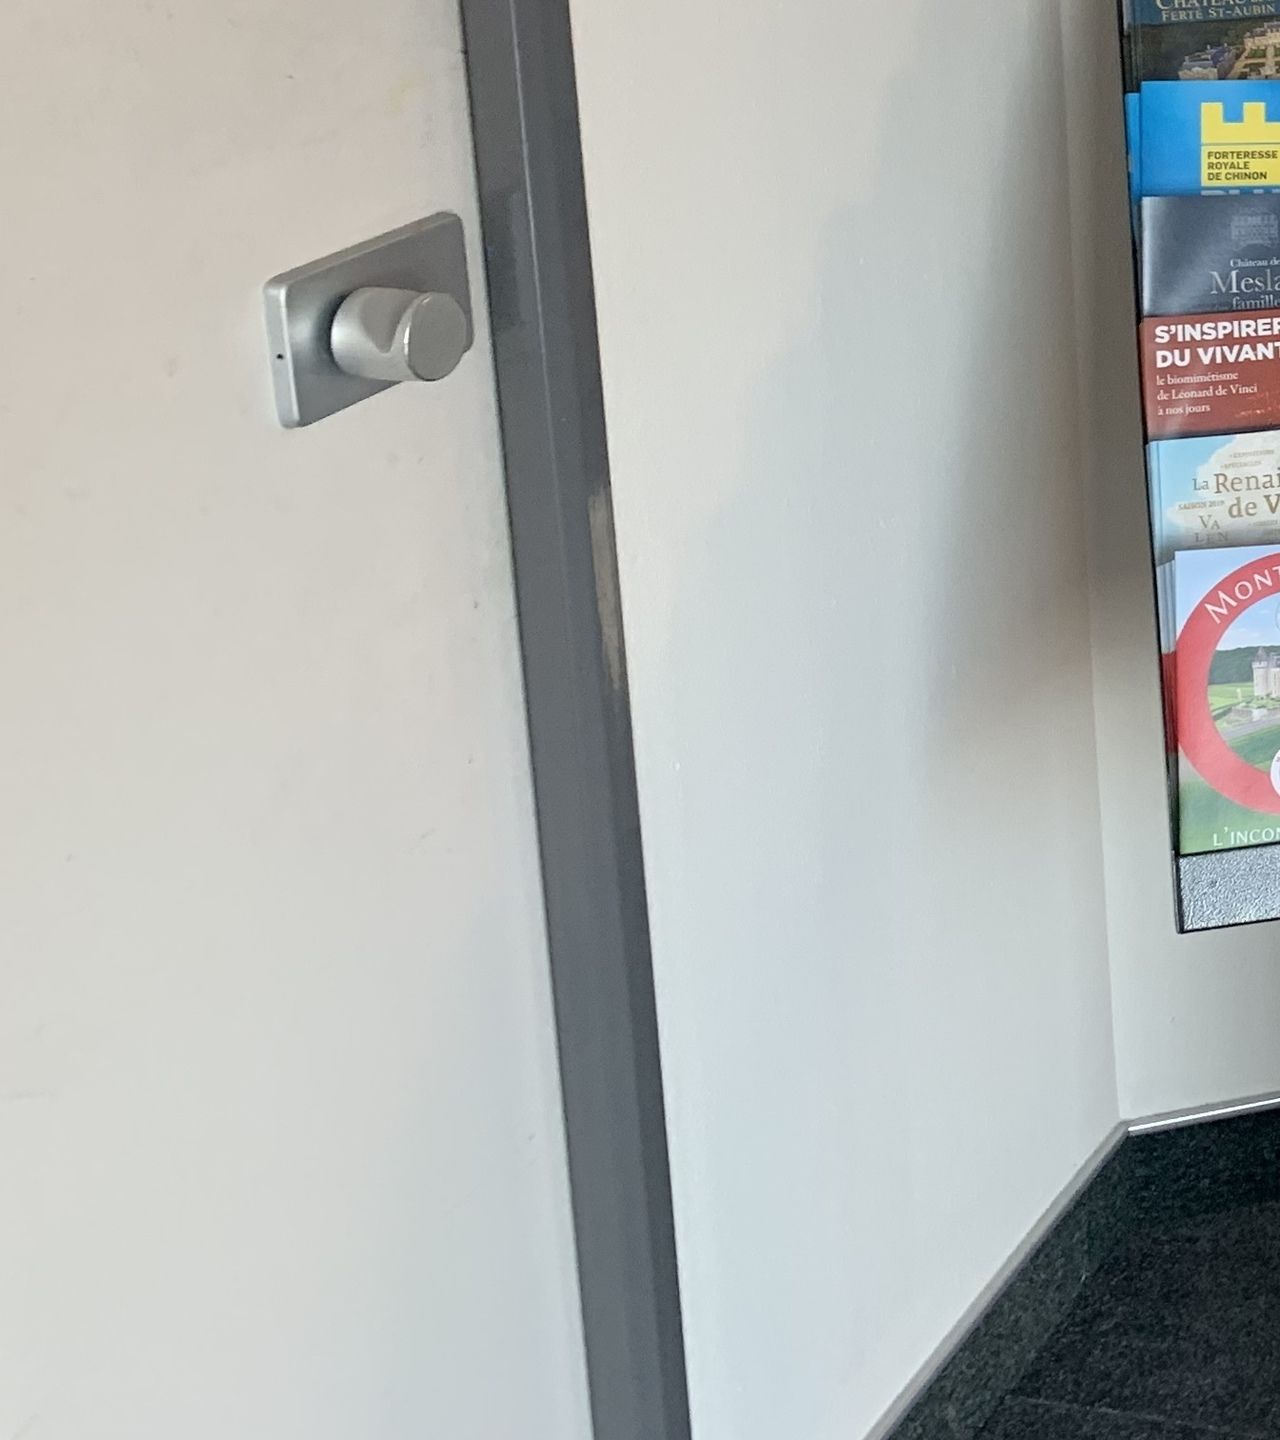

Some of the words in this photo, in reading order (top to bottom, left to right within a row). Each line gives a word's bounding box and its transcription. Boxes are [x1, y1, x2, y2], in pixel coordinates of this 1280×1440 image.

[1207, 150, 1278, 160] FORTERESSE
[1207, 161, 1249, 170] ROYALE
[1207, 172, 1222, 180] DE
[1225, 172, 1267, 180] CHINON
[1230, 257, 1269, 267] Château
[1156, 350, 1190, 368] DU
[1156, 374, 1165, 385] le
[1168, 371, 1239, 385] biomimétisme
[1157, 390, 1169, 400] de
[1172, 388, 1213, 400] Léonard
[1216, 386, 1227, 396] de
[1230, 384, 1257, 394] Vinci
[1166, 407, 1183, 415] nos
[1184, 404, 1210, 418] jours
[1193, 478, 1209, 490] La
[1228, 496, 1257, 518] de
